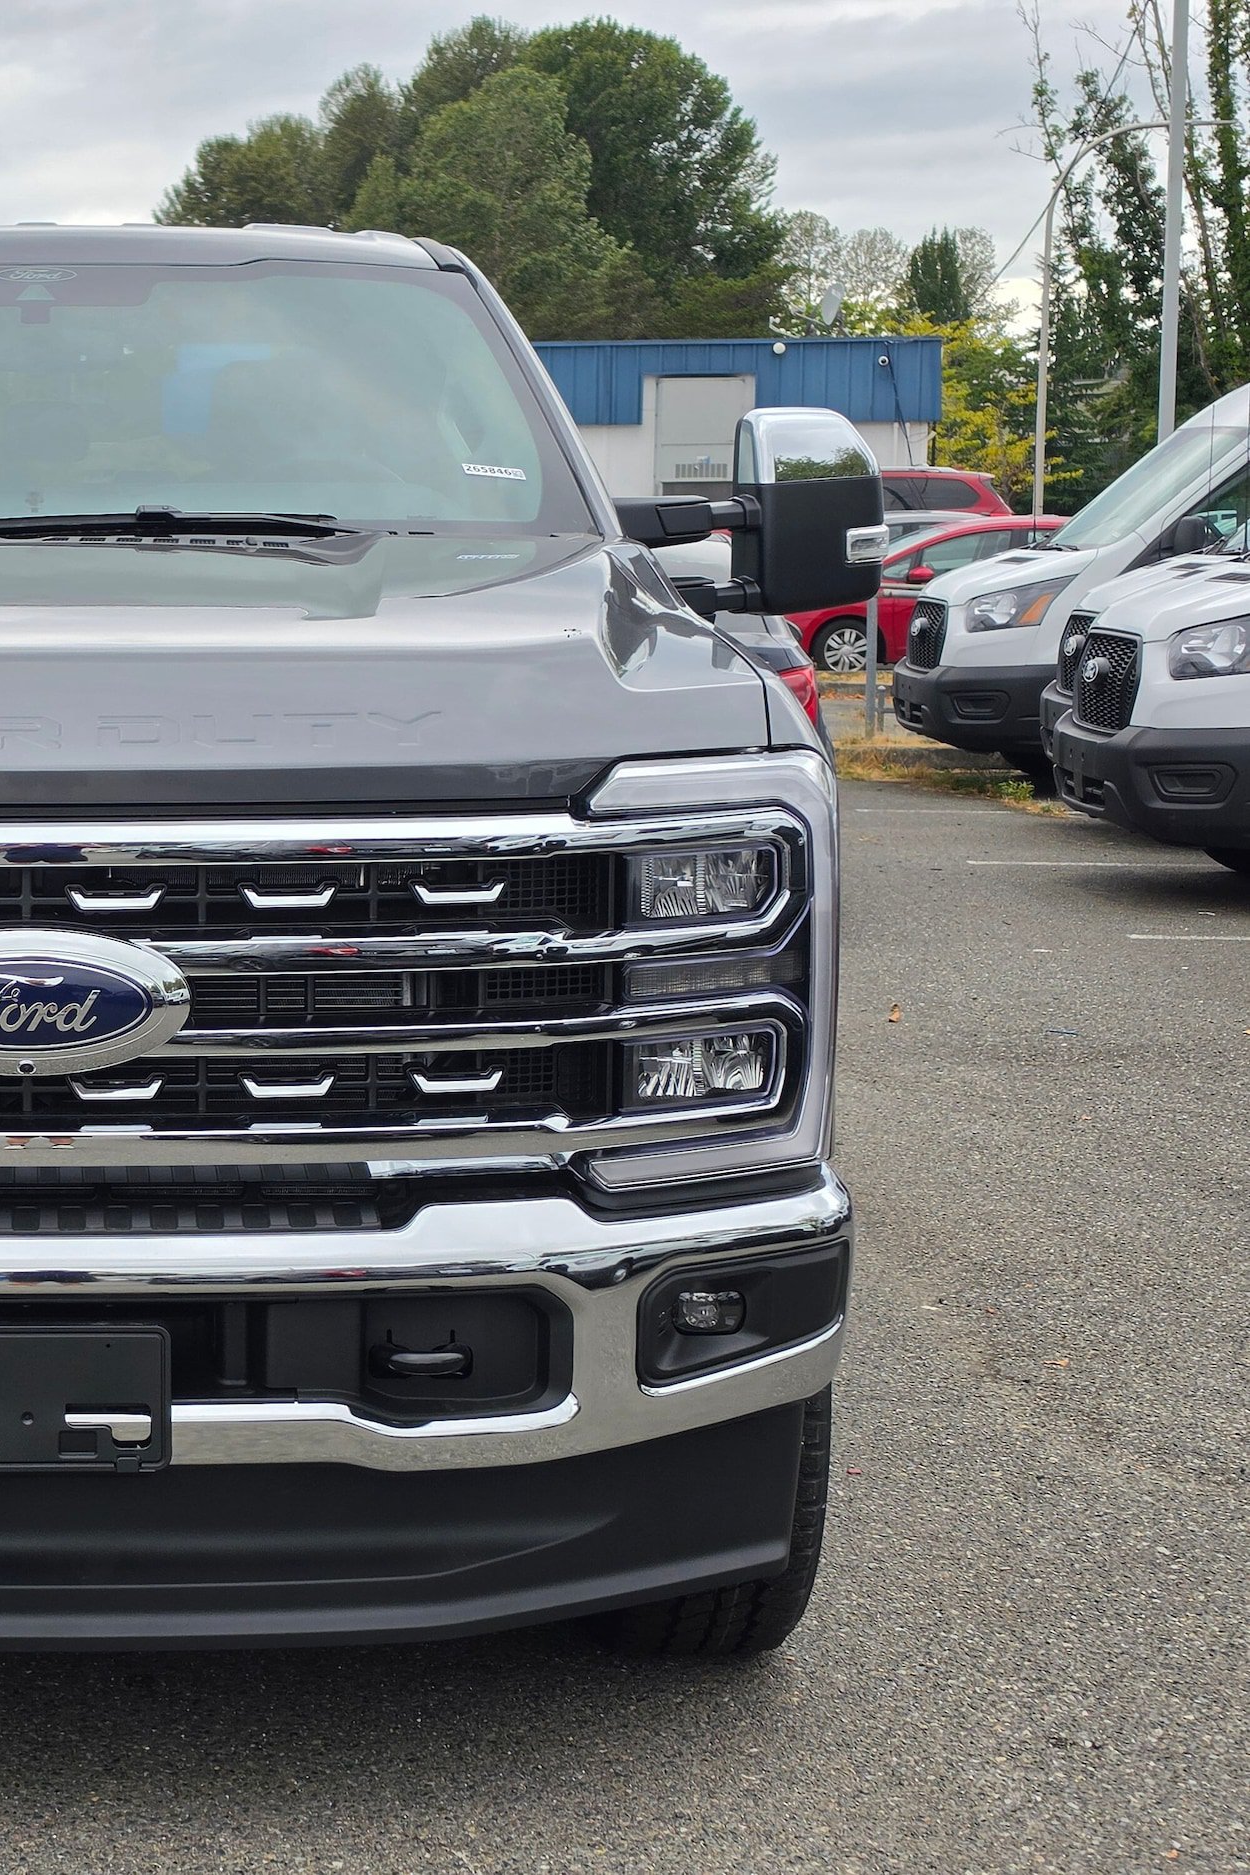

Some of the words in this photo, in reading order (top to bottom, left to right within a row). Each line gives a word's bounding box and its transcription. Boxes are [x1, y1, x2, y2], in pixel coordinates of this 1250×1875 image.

[9, 269, 63, 280] Ford
[465, 465, 512, 476] 265846
[96, 711, 443, 748] DUTY
